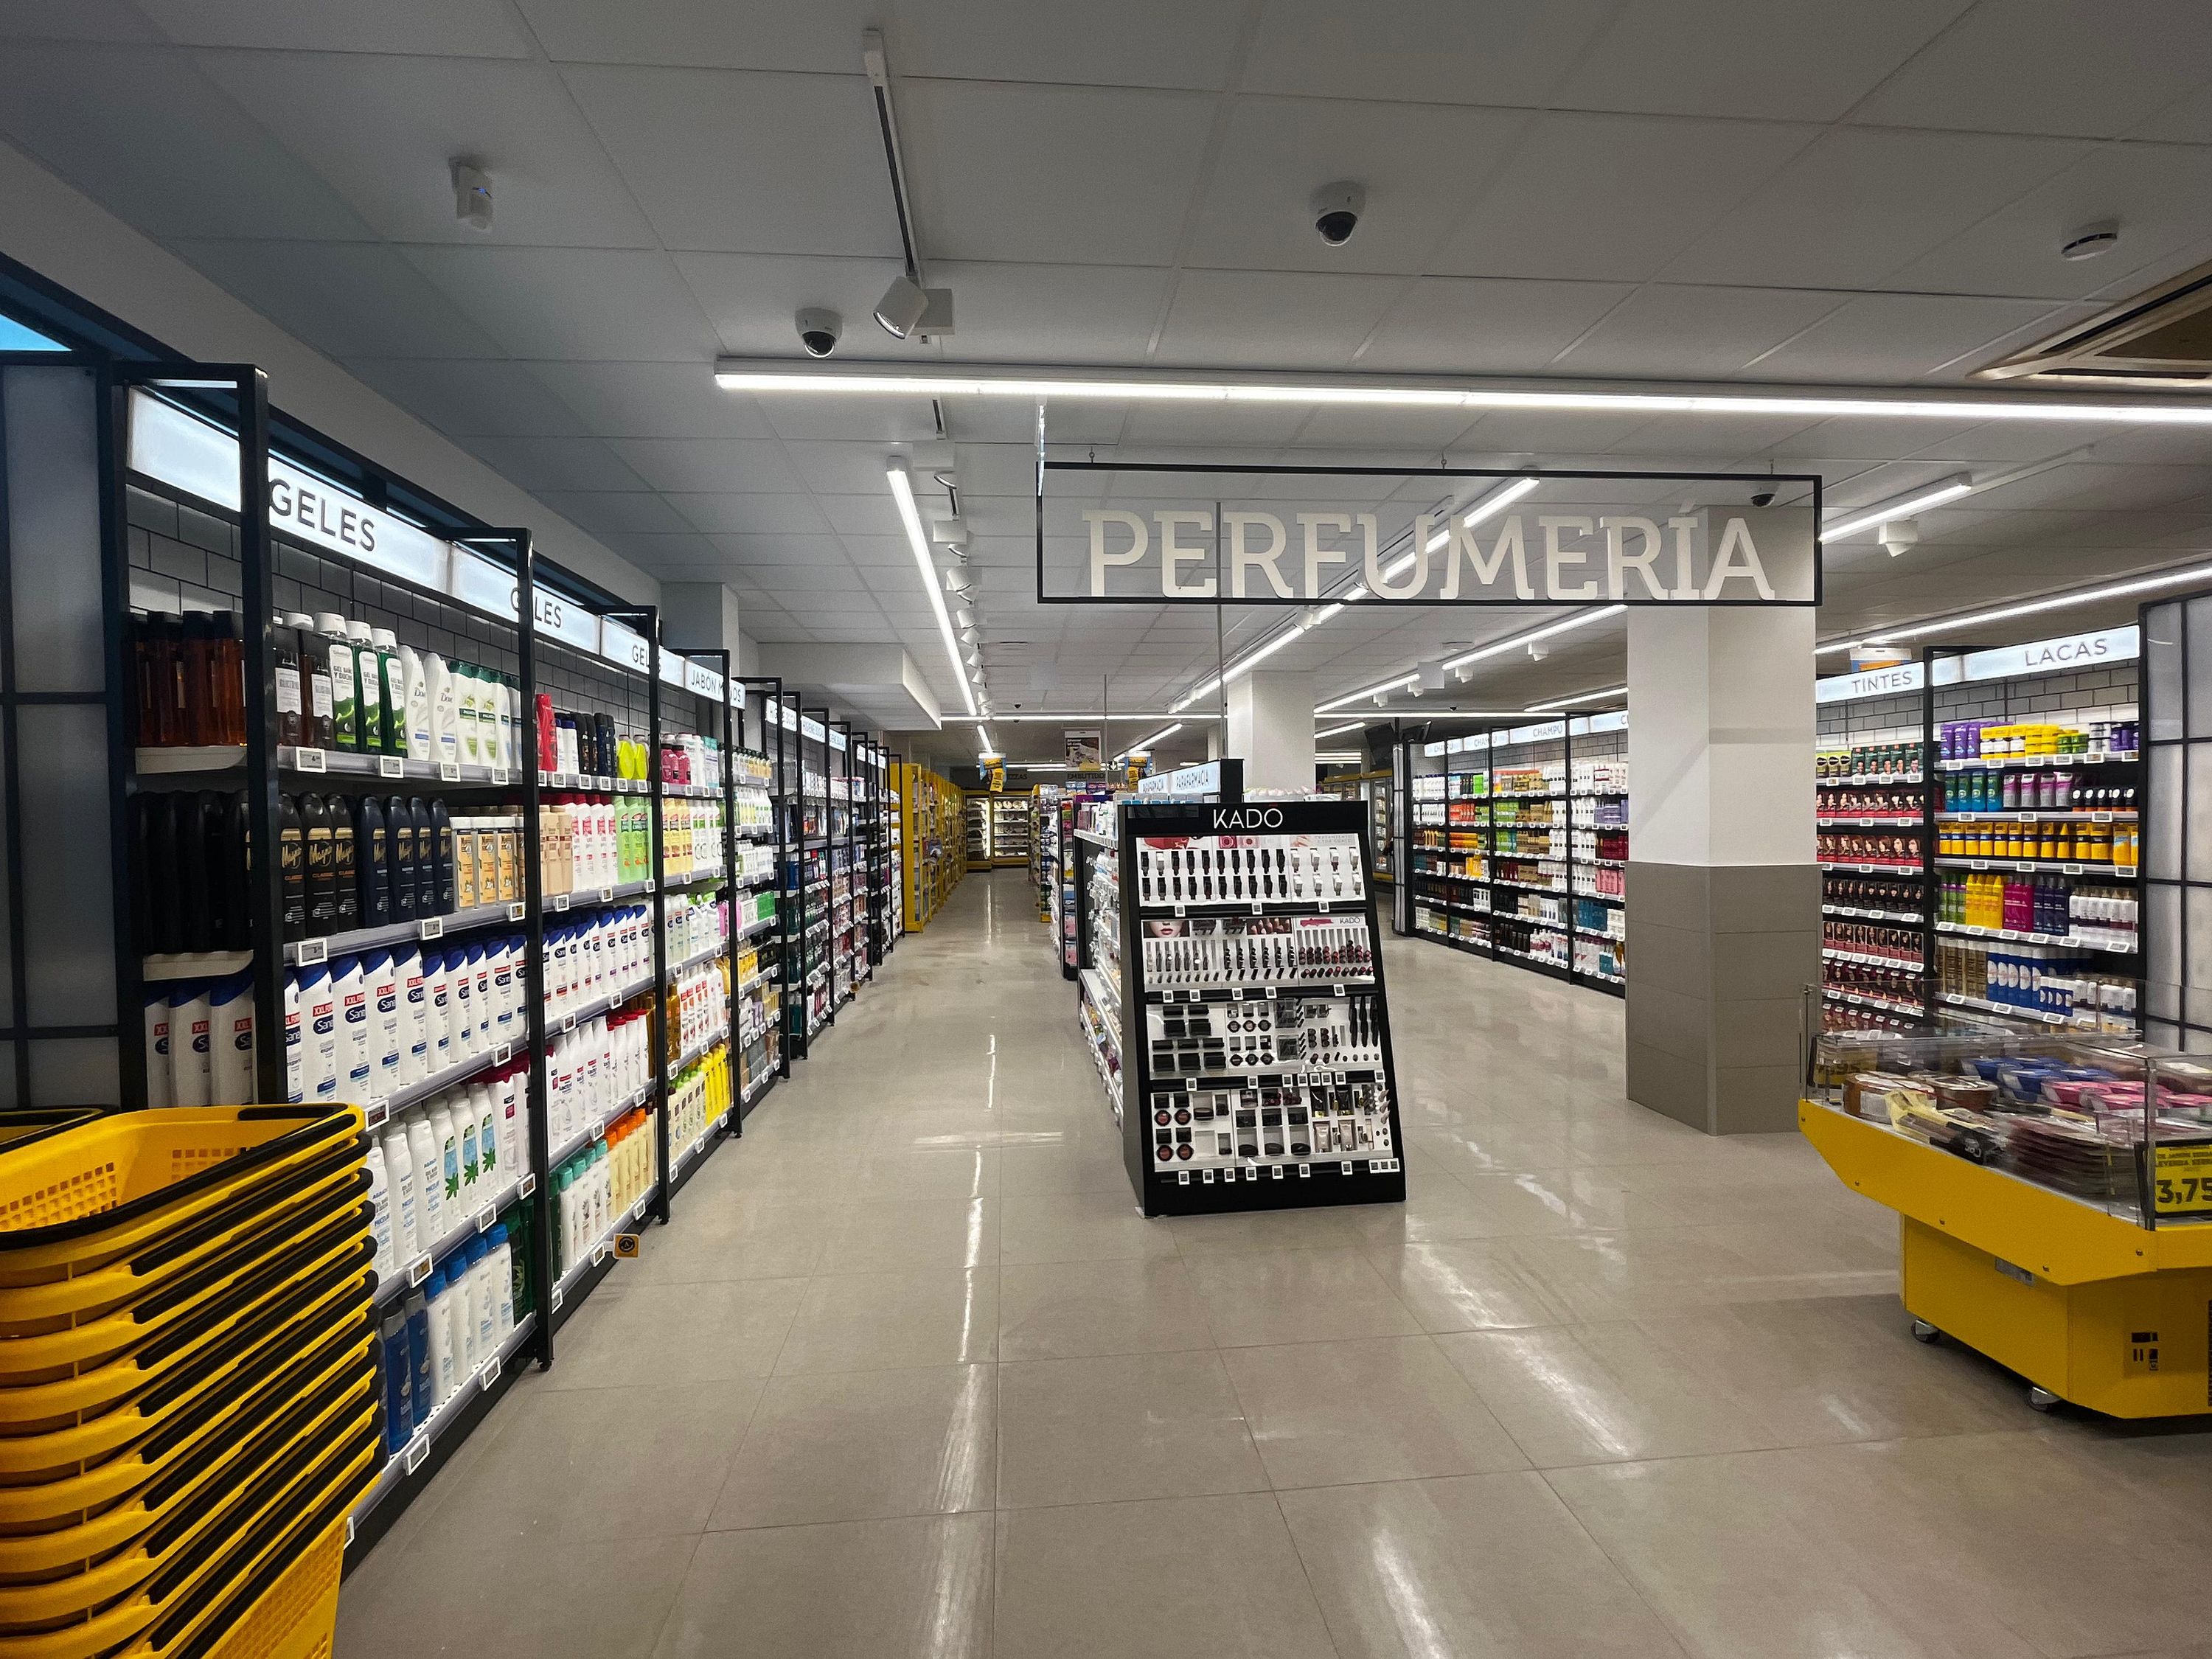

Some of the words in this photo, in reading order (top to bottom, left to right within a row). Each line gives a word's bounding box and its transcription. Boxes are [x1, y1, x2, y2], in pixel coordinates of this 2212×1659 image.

[268, 478, 377, 552] GELES
[509, 588, 563, 629] GLES
[2023, 639, 2109, 667] LACAS
[691, 670, 717, 692] JABÓN
[1851, 671, 1913, 694] TINTES
[1532, 722, 1562, 737] CHAMPÚ
[1213, 808, 1284, 830] KADO
